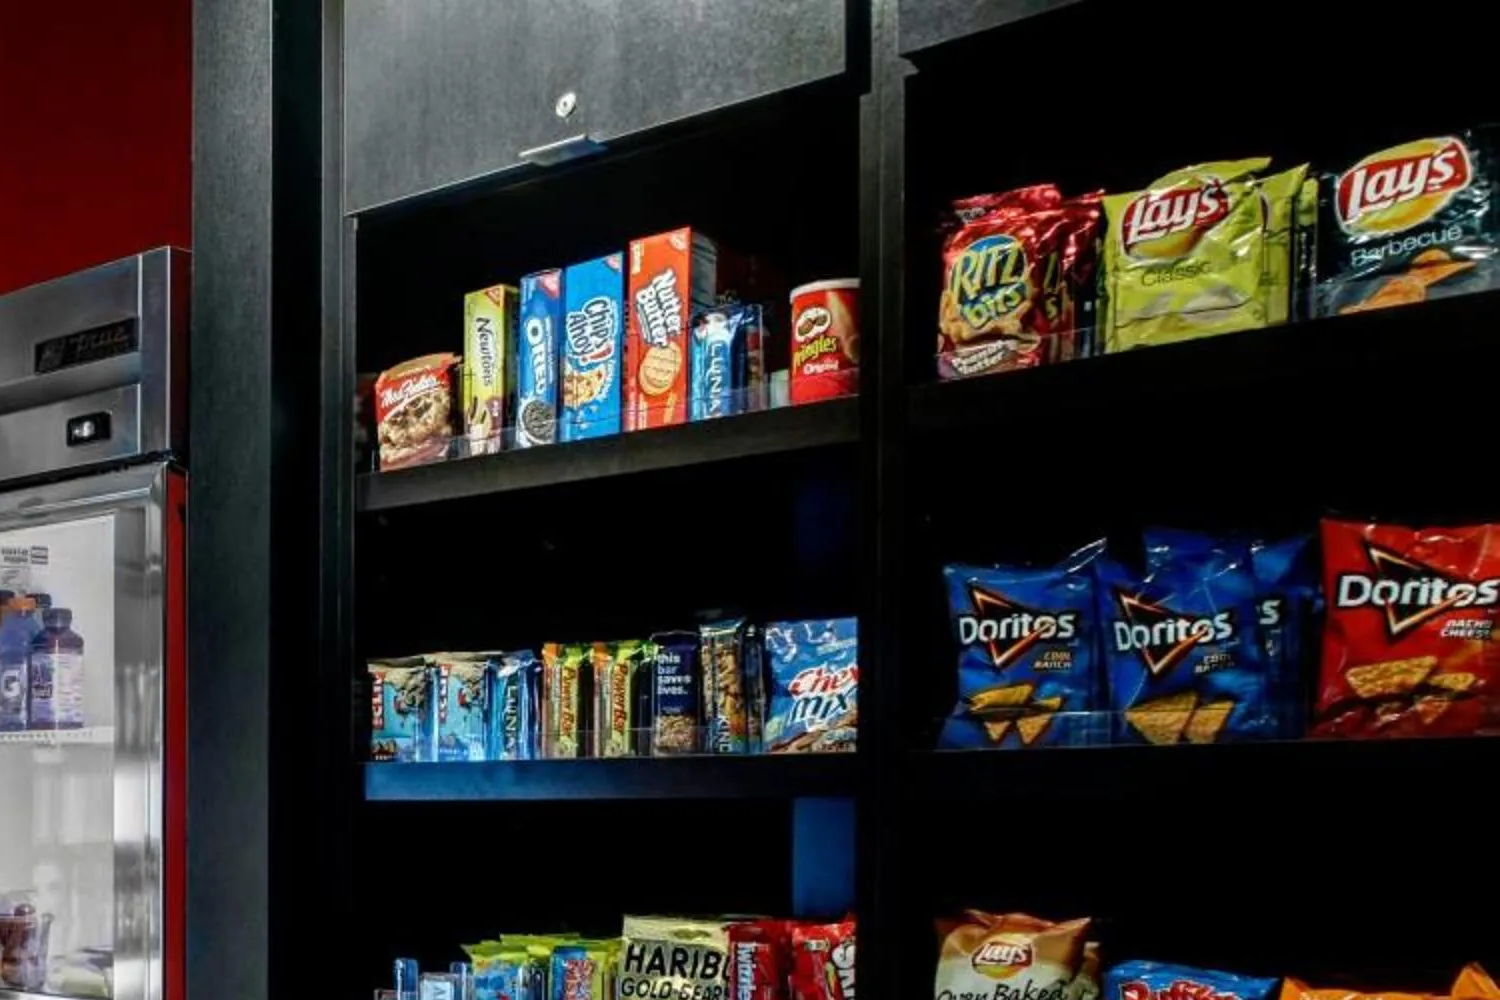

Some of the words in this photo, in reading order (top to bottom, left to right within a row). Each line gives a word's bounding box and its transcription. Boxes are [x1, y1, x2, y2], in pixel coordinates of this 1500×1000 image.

[1346, 145, 1458, 224] Lay's
[1351, 226, 1463, 266] Barbecue
[954, 242, 1022, 300] RITZ
[1141, 259, 1212, 287] Classic
[636, 285, 668, 348] Butter
[653, 268, 682, 337] Nutter
[583, 297, 614, 350] Chips
[476, 316, 496, 388] Newtons
[526, 317, 547, 396] OREO
[1337, 574, 1500, 608] Doritos
[959, 612, 1077, 645] Doritos
[1113, 612, 1233, 651] Doritos
[657, 652, 681, 664] this
[657, 664, 678, 675] bar
[657, 675, 691, 685] saves
[788, 662, 860, 697] Chex
